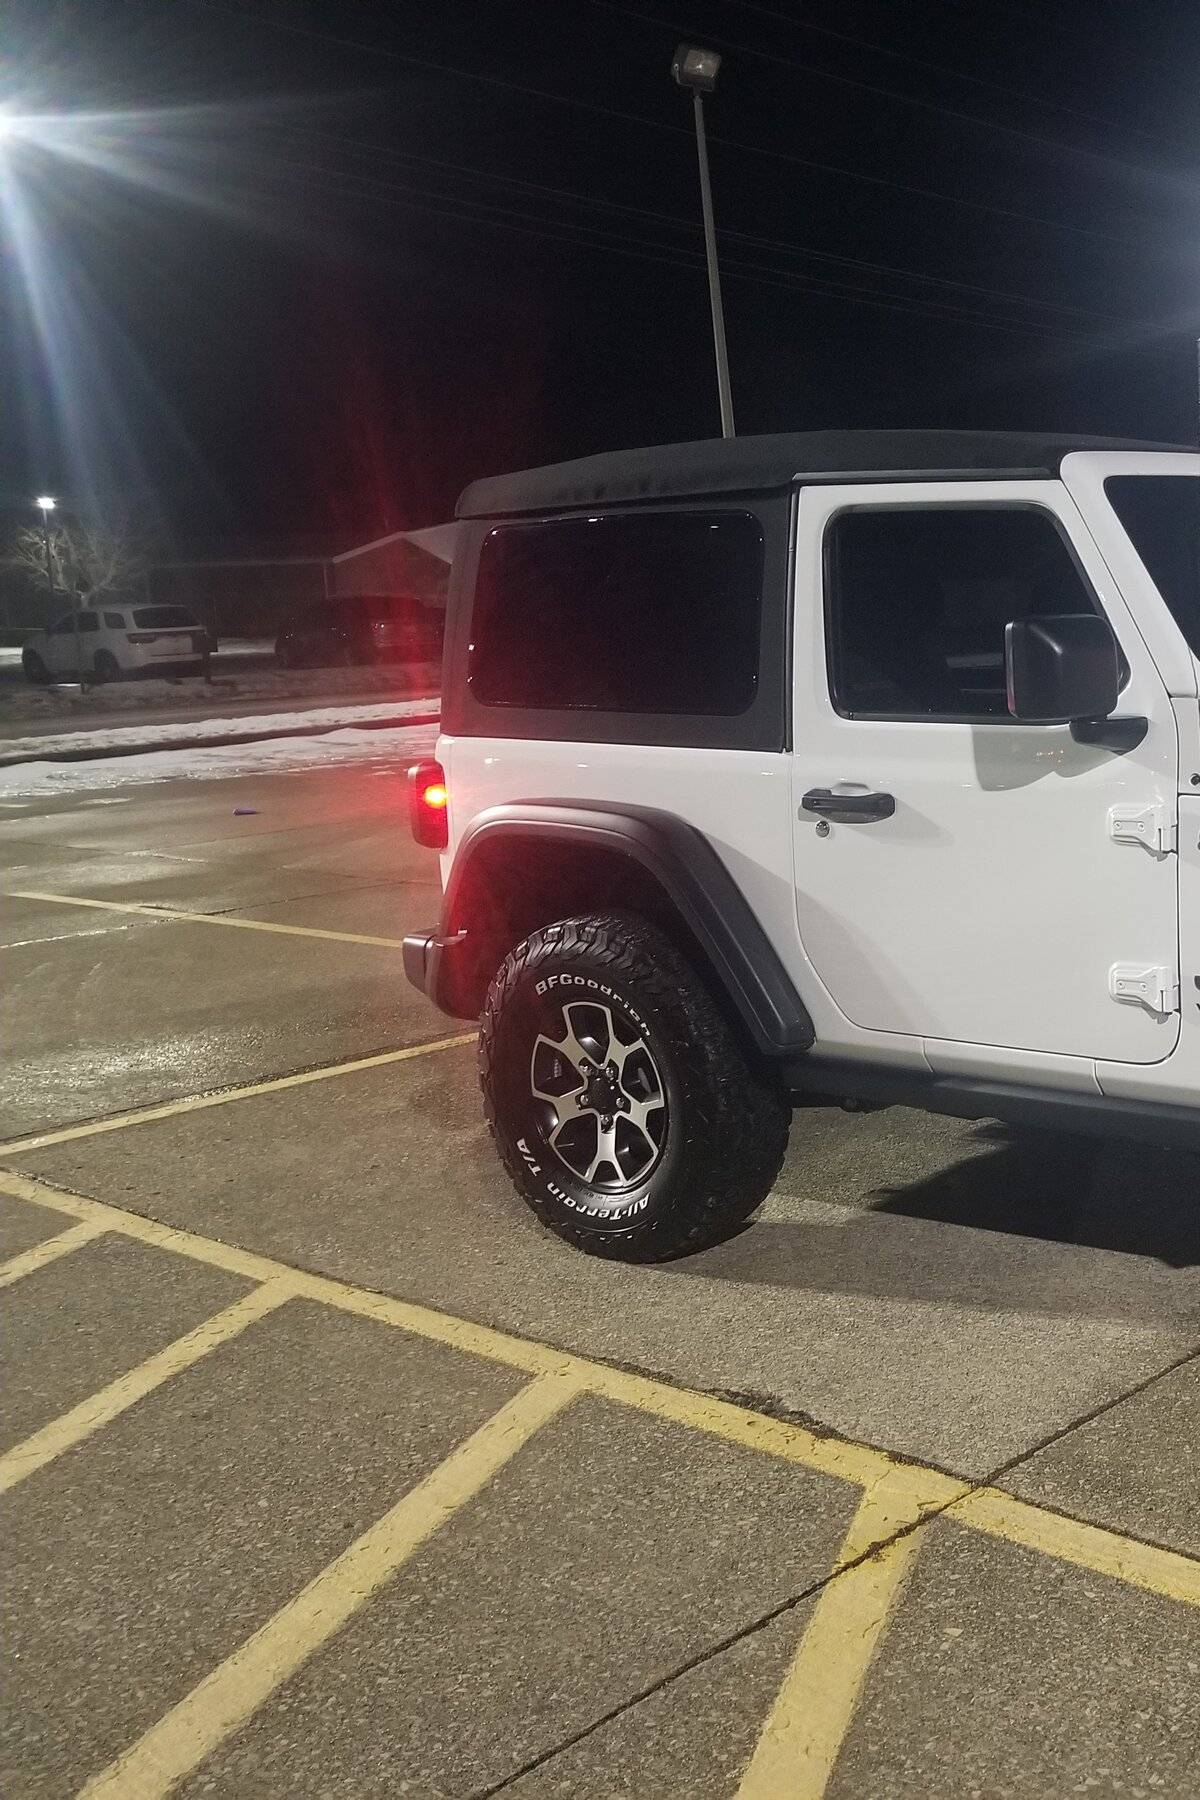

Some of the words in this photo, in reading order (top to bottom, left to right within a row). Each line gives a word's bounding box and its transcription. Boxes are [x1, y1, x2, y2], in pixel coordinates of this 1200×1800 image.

[535, 974, 650, 1036] BFGoodrich
[516, 1138, 541, 1176] T/A
[547, 1182, 650, 1220] All-Terrain
